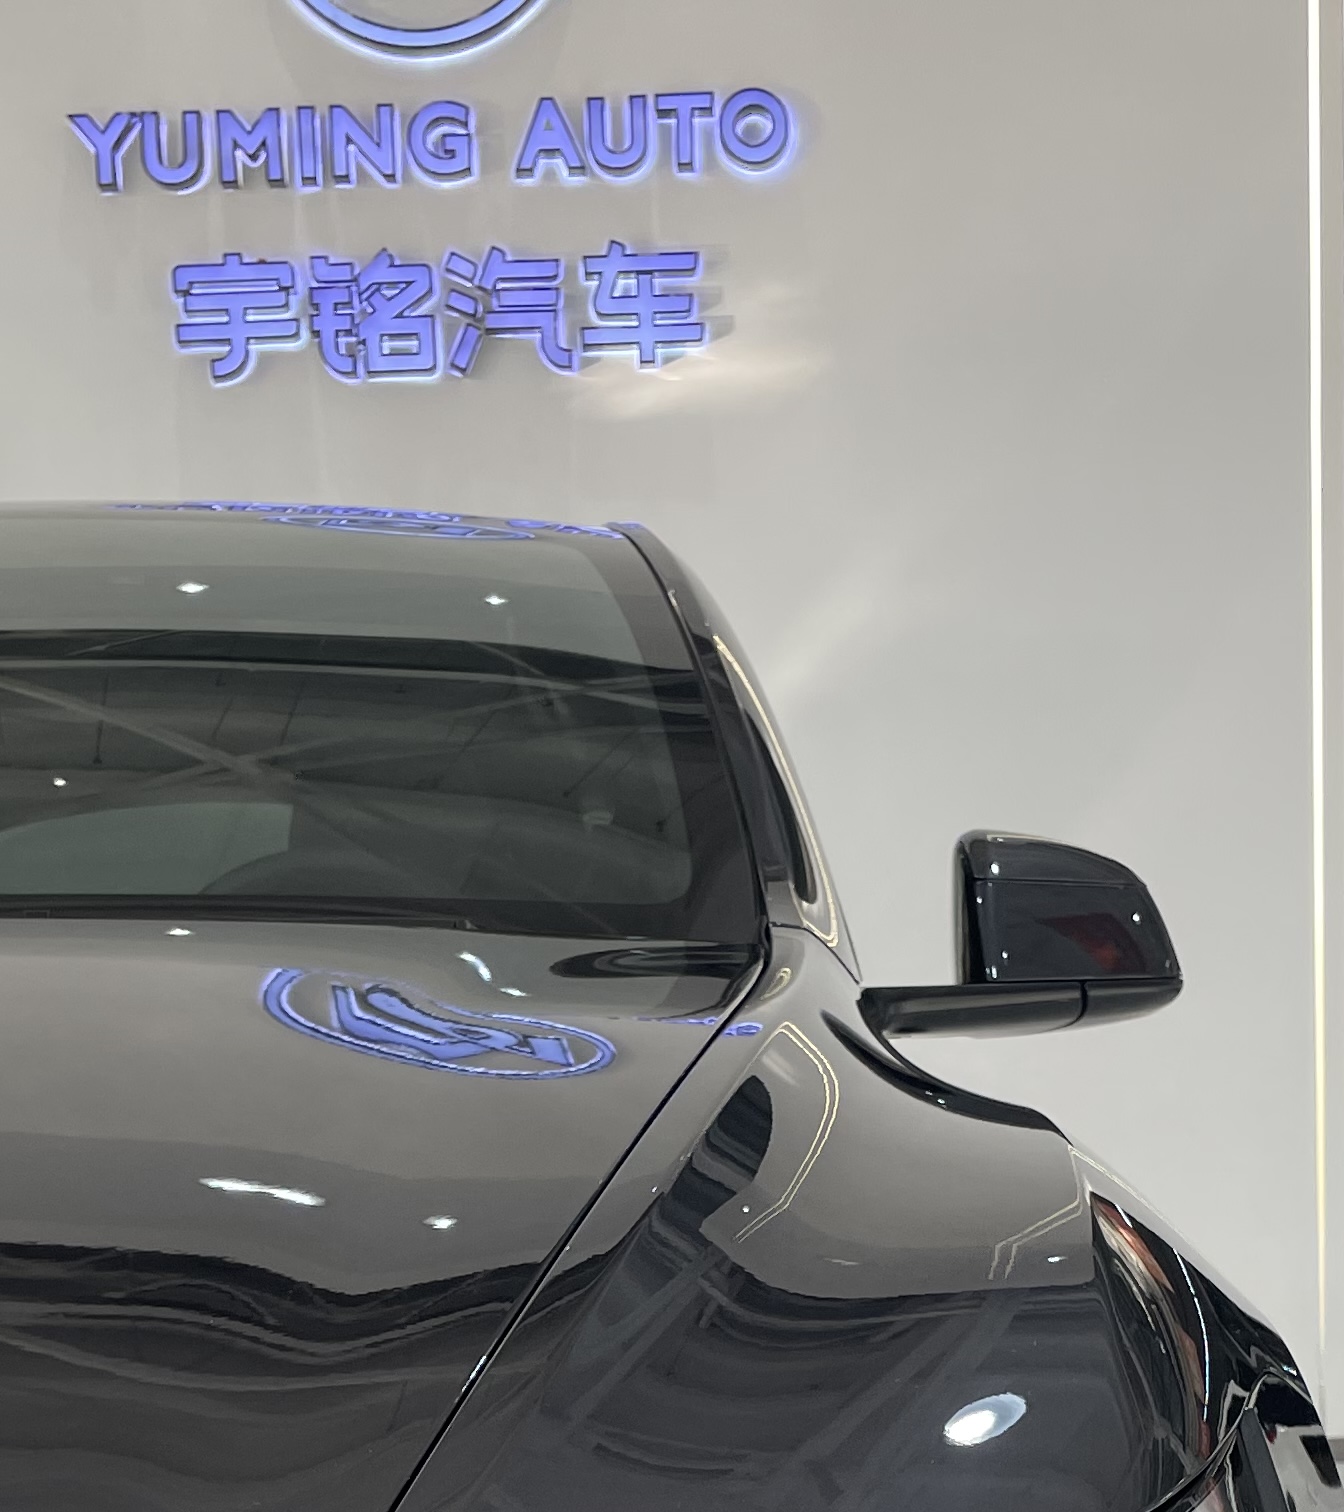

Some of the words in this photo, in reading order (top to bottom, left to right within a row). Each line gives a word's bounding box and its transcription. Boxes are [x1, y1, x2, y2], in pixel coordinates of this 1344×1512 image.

[67, 98, 475, 194] YUMING
[513, 86, 793, 184] AUTO
[171, 240, 707, 385] 宇铭汽车
